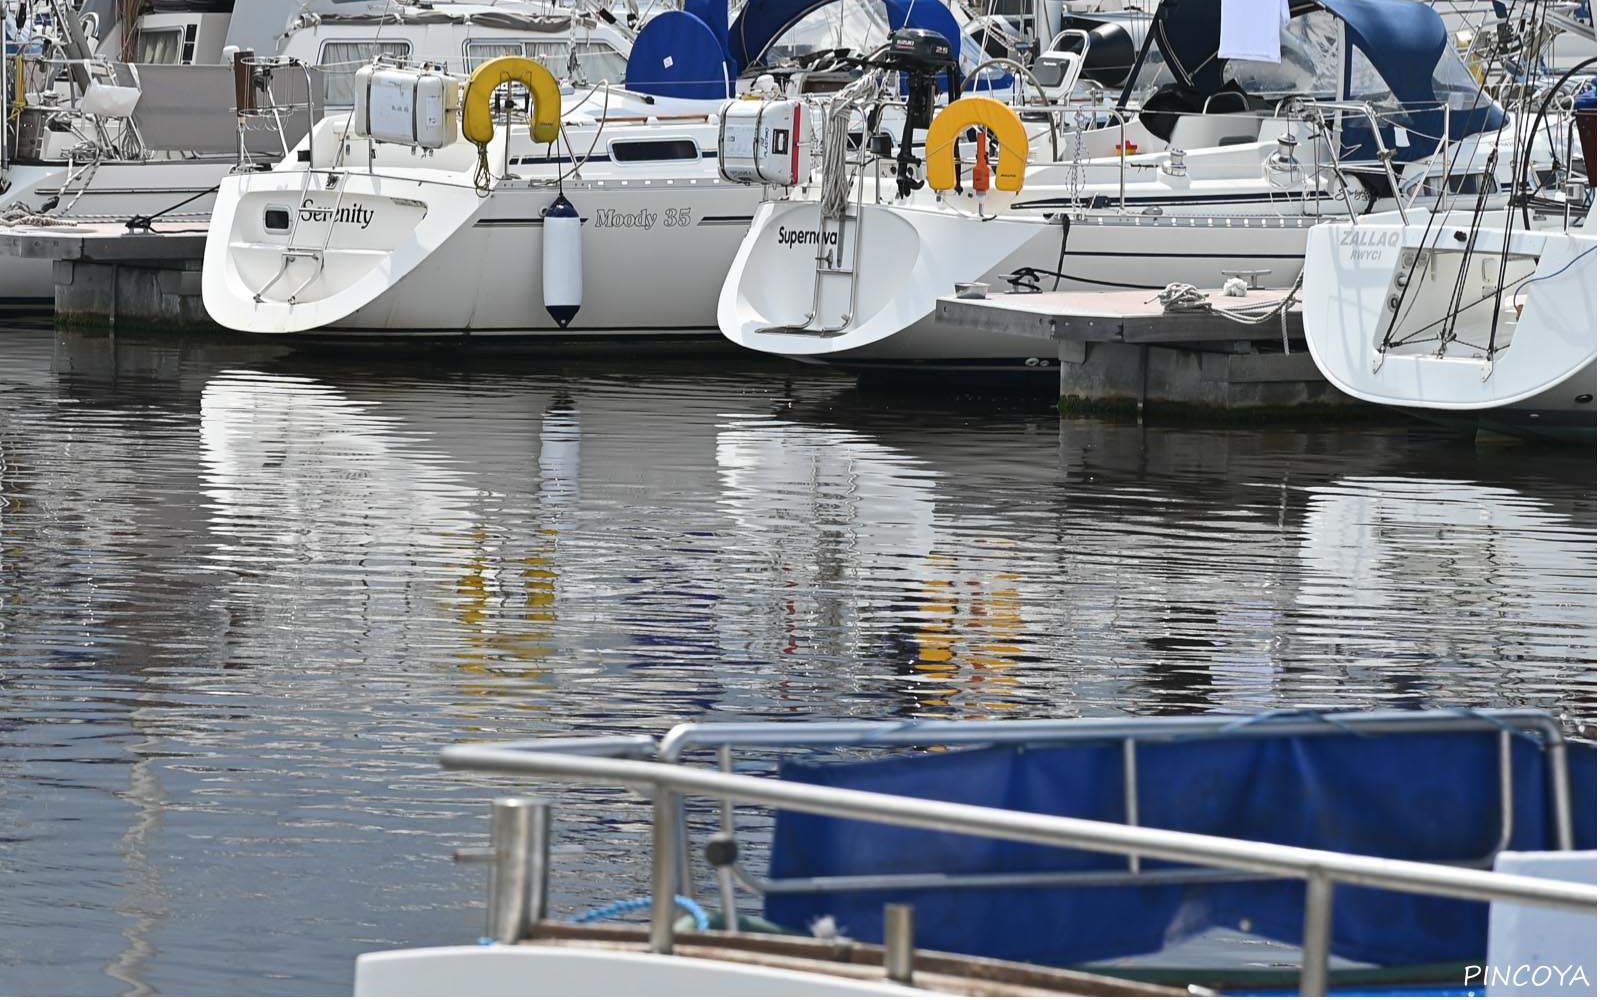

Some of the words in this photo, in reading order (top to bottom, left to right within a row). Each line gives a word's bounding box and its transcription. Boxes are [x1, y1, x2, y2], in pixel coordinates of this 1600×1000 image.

[301, 198, 375, 230] Serenity
[594, 208, 658, 231] Moody
[663, 207, 692, 228] 35
[1340, 230, 1400, 248] ZALLAQ
[1350, 249, 1383, 261] RWYCI
